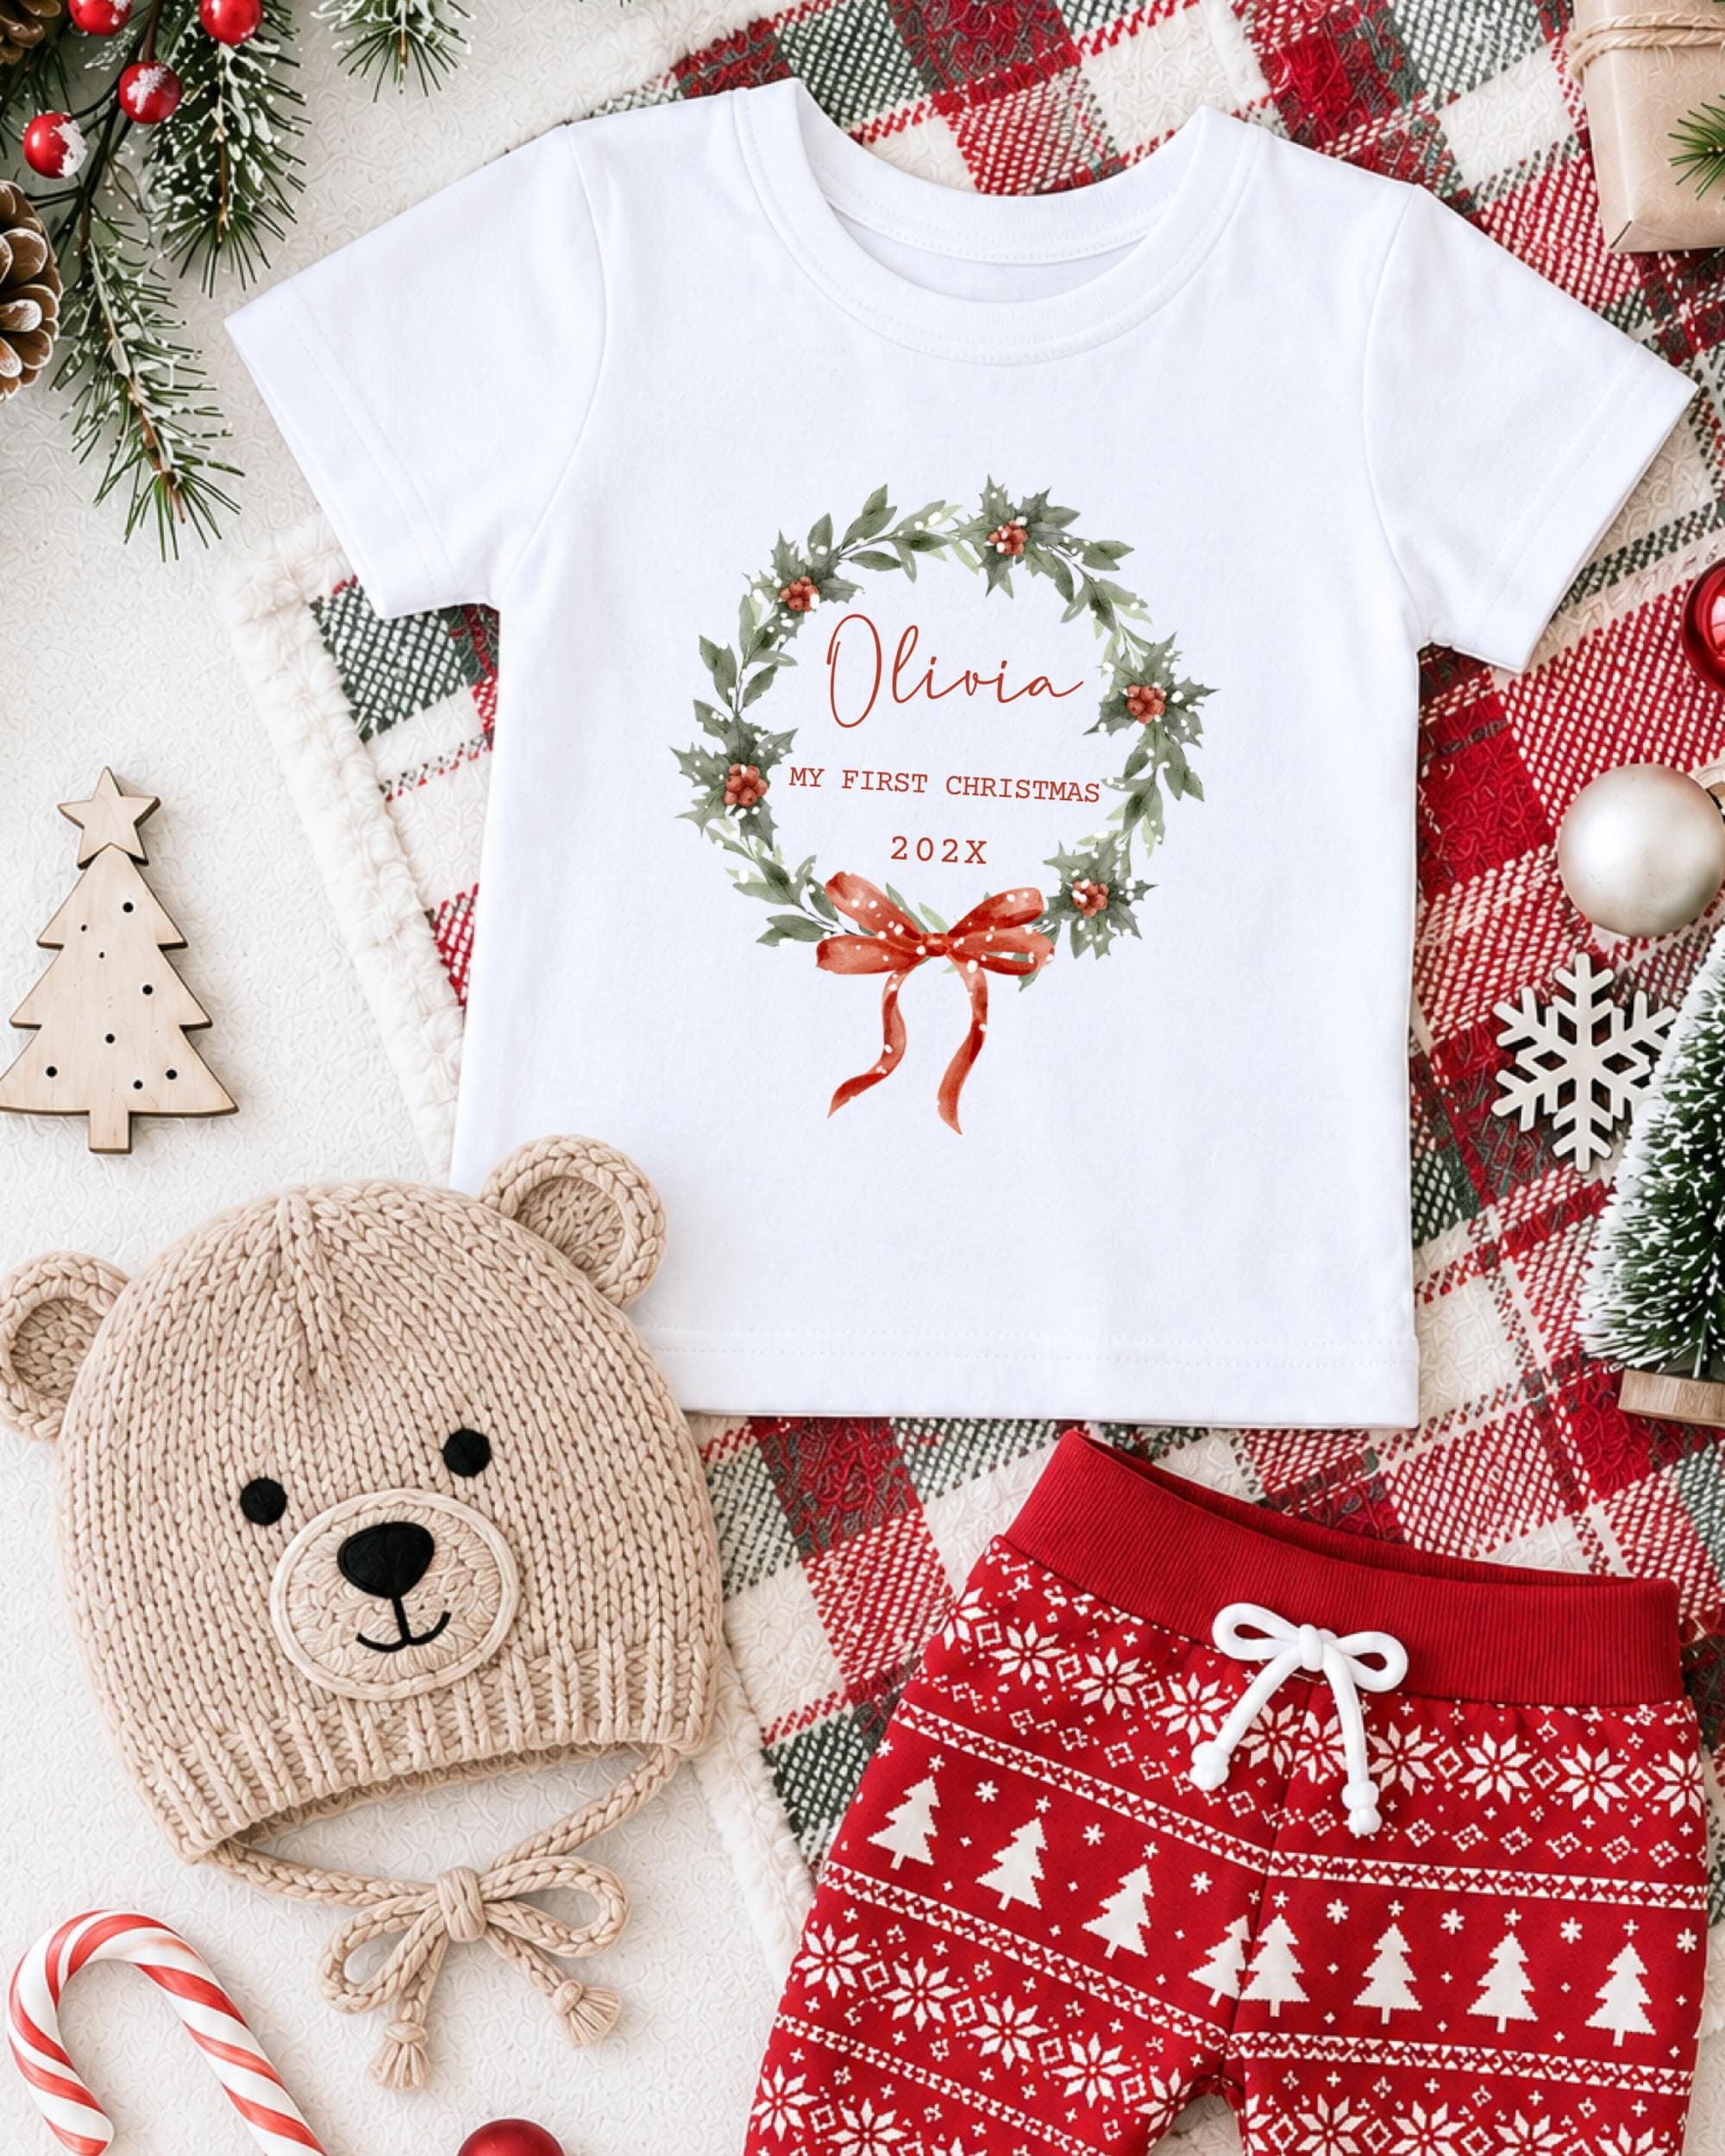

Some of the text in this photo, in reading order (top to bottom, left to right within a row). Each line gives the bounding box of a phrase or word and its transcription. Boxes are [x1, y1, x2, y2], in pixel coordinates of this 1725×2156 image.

[825, 613, 1084, 729] Olivia
[789, 766, 1100, 803] MY FIRST CHRISTMAS
[890, 835, 988, 865] 202X
